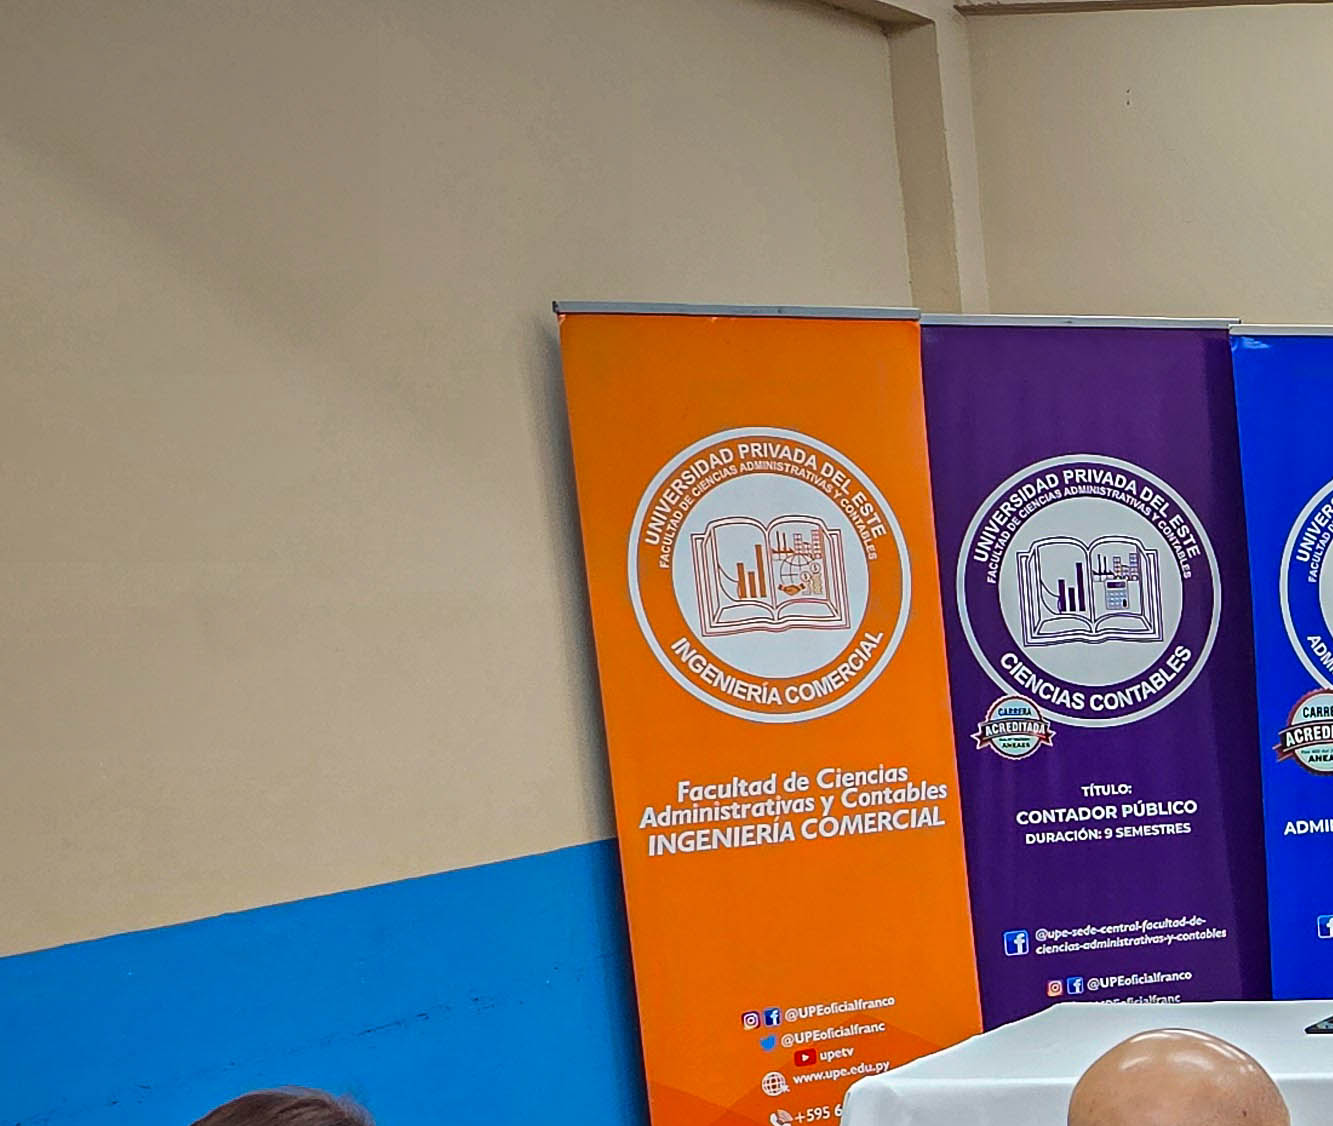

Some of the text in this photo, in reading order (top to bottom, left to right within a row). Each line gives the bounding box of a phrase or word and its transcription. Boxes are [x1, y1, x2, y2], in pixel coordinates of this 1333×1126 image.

[645, 442, 887, 546] UNIVERSIDAD PRIVADA DEL ESTE
[659, 460, 878, 569] FACULTAD DE CIENCIAS ADMINISTRATIVAS Y CONTABLES
[973, 468, 1201, 564] UNIVERSIDAD PRIVADA DEL ESTE
[986, 485, 1192, 584] FACULTAD DE CIENCIAS ADMINISTRATIVAS Y CONTABLES
[1308, 532, 1330, 583] FACULTAD
[671, 630, 884, 705] INGENIERÍA COMERCIAL
[1000, 645, 1193, 712] CIENCIAS CONTABLES
[985, 721, 1046, 737] ACREDITADA
[677, 764, 908, 802] Facultad de Ciencias
[1081, 783, 1132, 797] TÍTULO:
[639, 781, 947, 829] Administrativas y Contables
[1016, 800, 1198, 825] CONTADOR PÚBLICO
[648, 806, 946, 857] INGENIERÍA COMERCIAL
[1026, 822, 1192, 845] DURACIÓN: 9 SEMESTRES
[1087, 971, 1192, 991] @UPEoficialfranco
[784, 996, 895, 1022] @UPEoficialfranco
[781, 1022, 886, 1048] @UPEoficialfranc
[819, 1047, 855, 1063] upetv
[792, 1061, 890, 1085] www.upe.edu.py
[794, 1106, 830, 1124] +595
